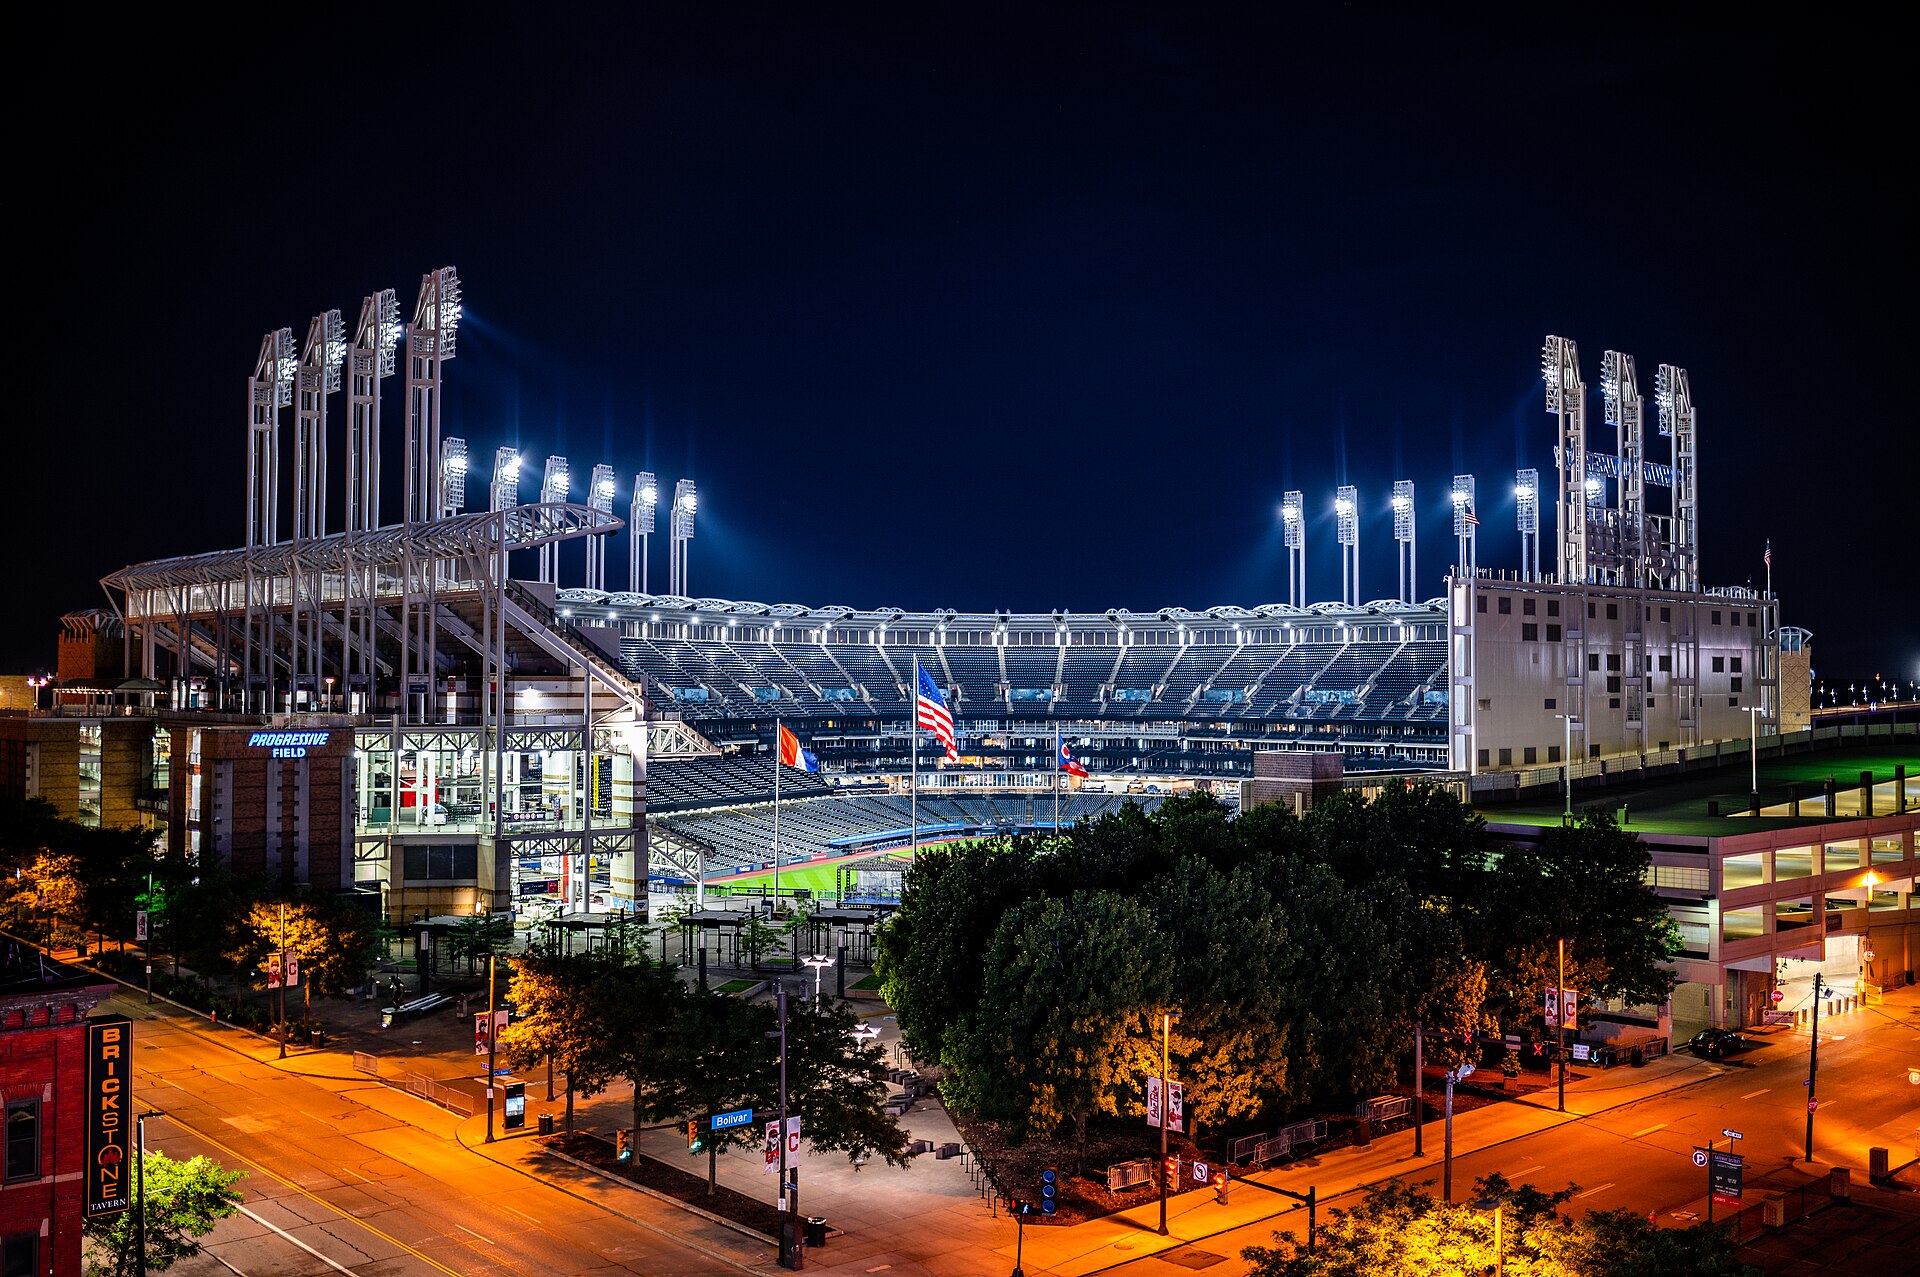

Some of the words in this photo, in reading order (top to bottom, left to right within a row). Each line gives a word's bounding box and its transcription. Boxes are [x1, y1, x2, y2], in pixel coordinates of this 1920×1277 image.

[248, 732, 330, 747] PROGRESSIVE
[272, 747, 306, 758] FIELD
[288, 962, 297, 976] C
[1565, 1002, 1576, 1017] C
[98, 1028, 123, 1199] BRICKSTONE
[716, 1113, 748, 1127] Bolivar
[788, 1132, 799, 1152] C
[1696, 1154, 1704, 1164] P
[90, 1198, 126, 1211] TAVERN
